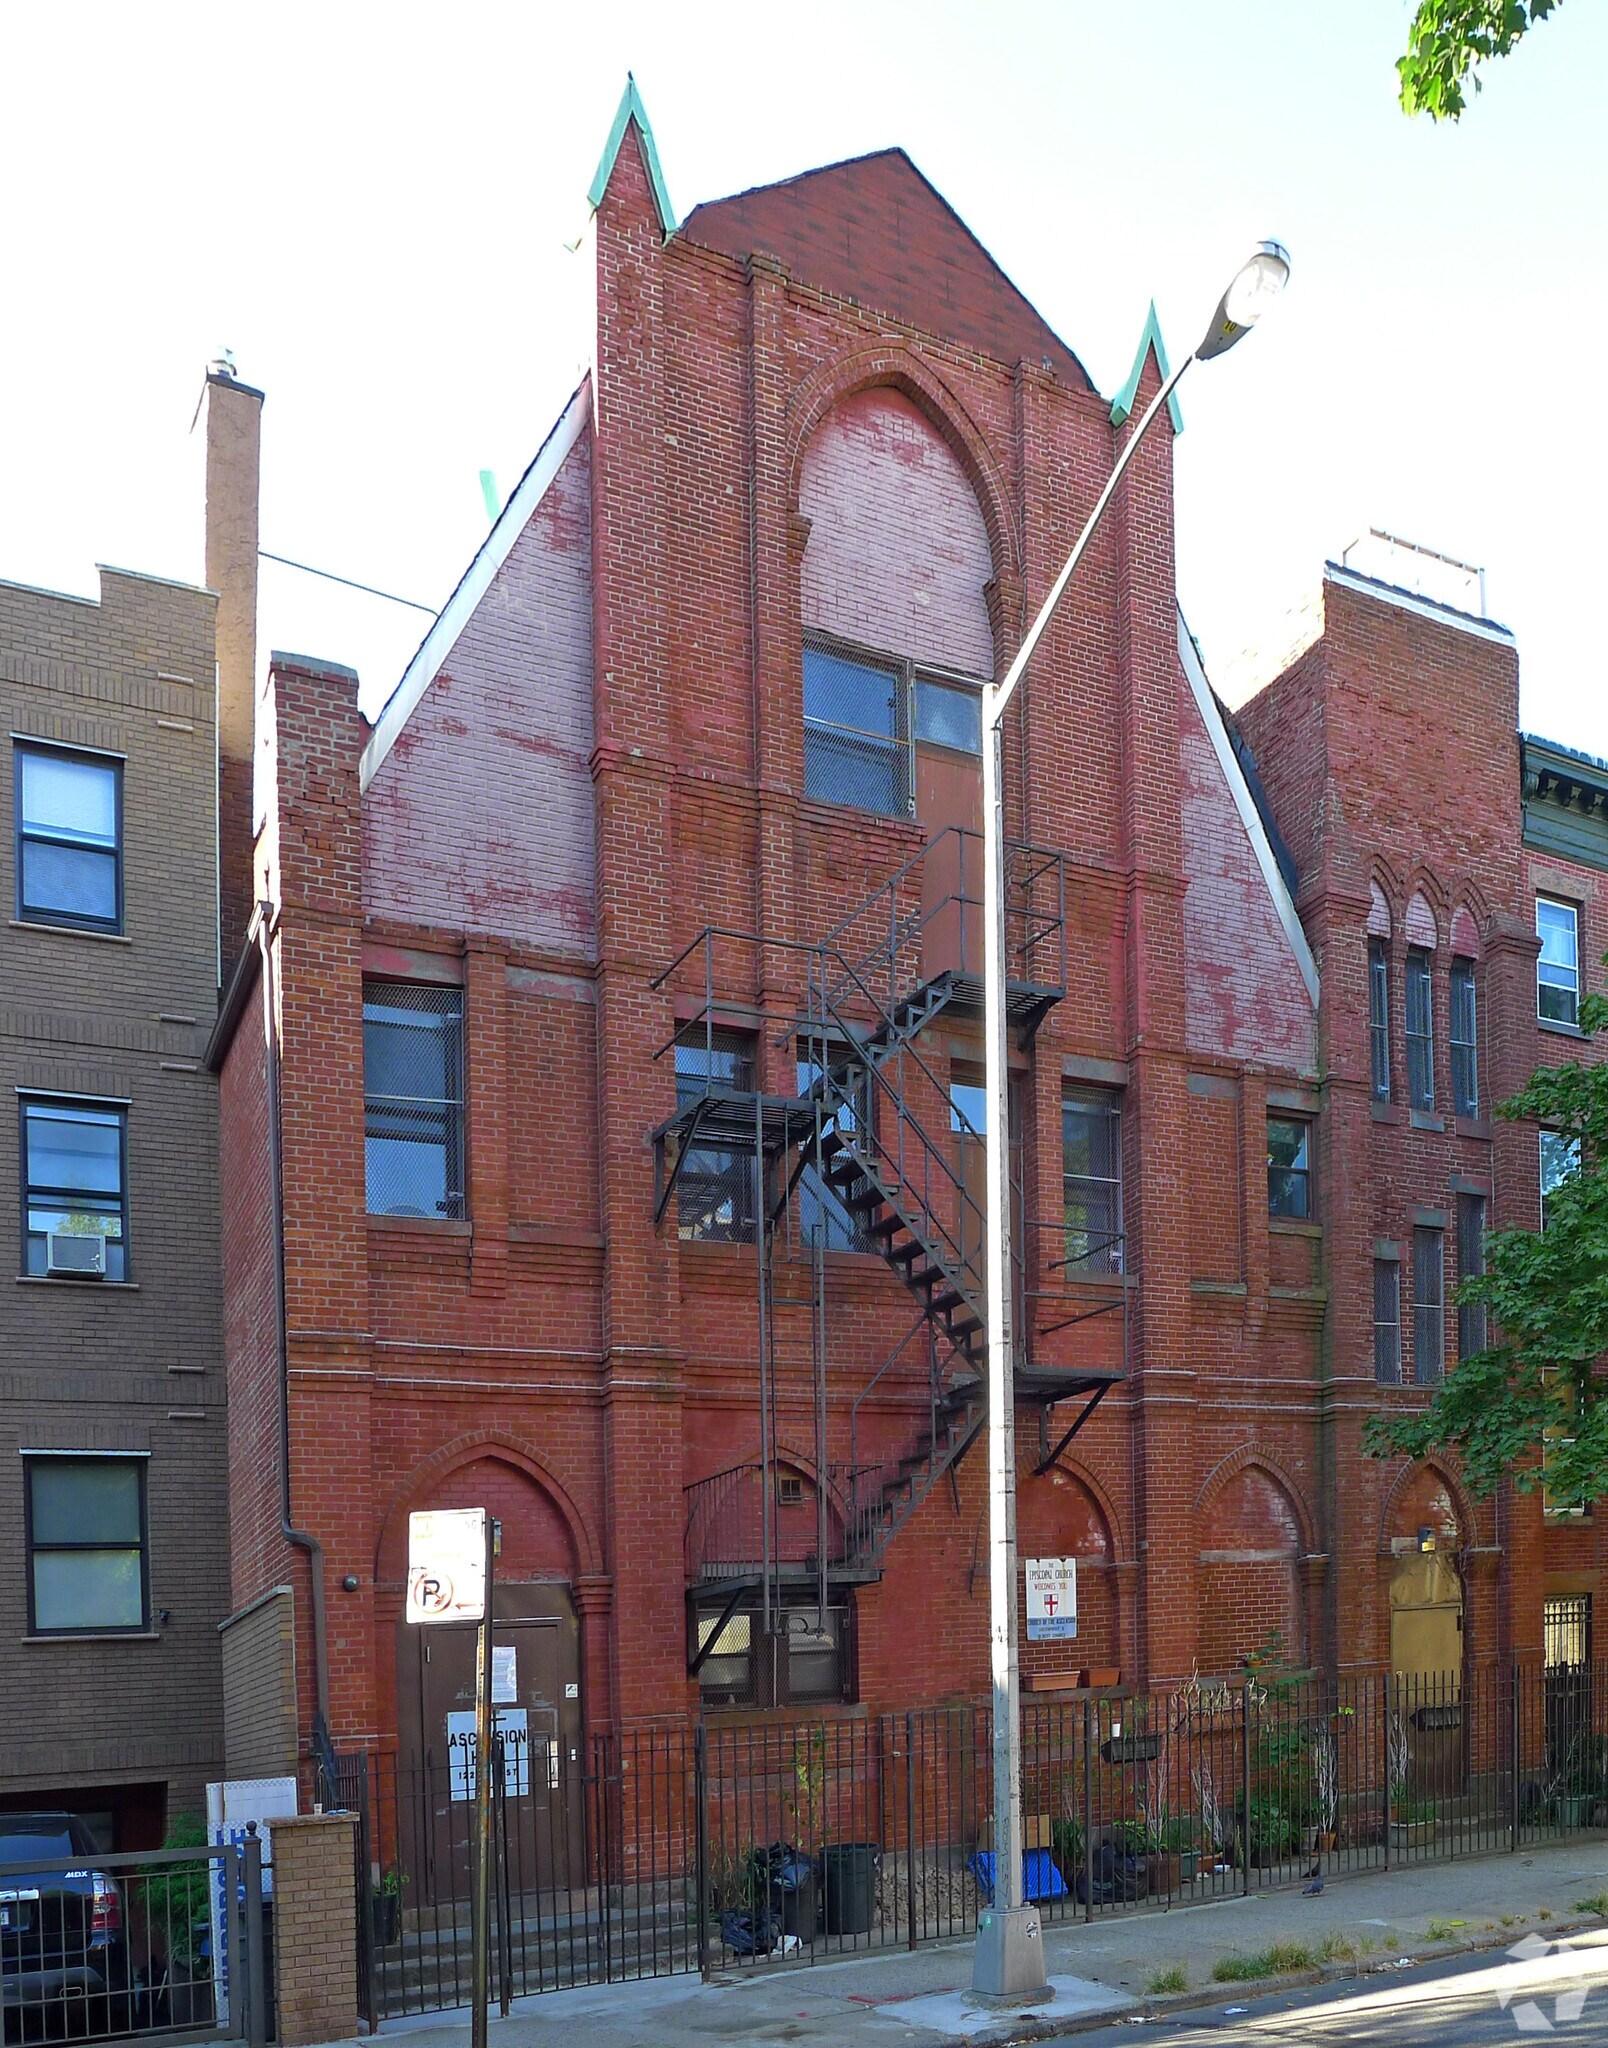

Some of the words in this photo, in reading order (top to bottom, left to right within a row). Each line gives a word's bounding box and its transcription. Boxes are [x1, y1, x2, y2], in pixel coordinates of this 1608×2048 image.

[1029, 1569, 1053, 1580] EPISCOPAL
[1055, 1569, 1073, 1579] CHURCH
[1034, 1582, 1056, 1591] WELCOMES
[1059, 1582, 1068, 1590] YOU
[449, 1729, 527, 1747] ASCSION
